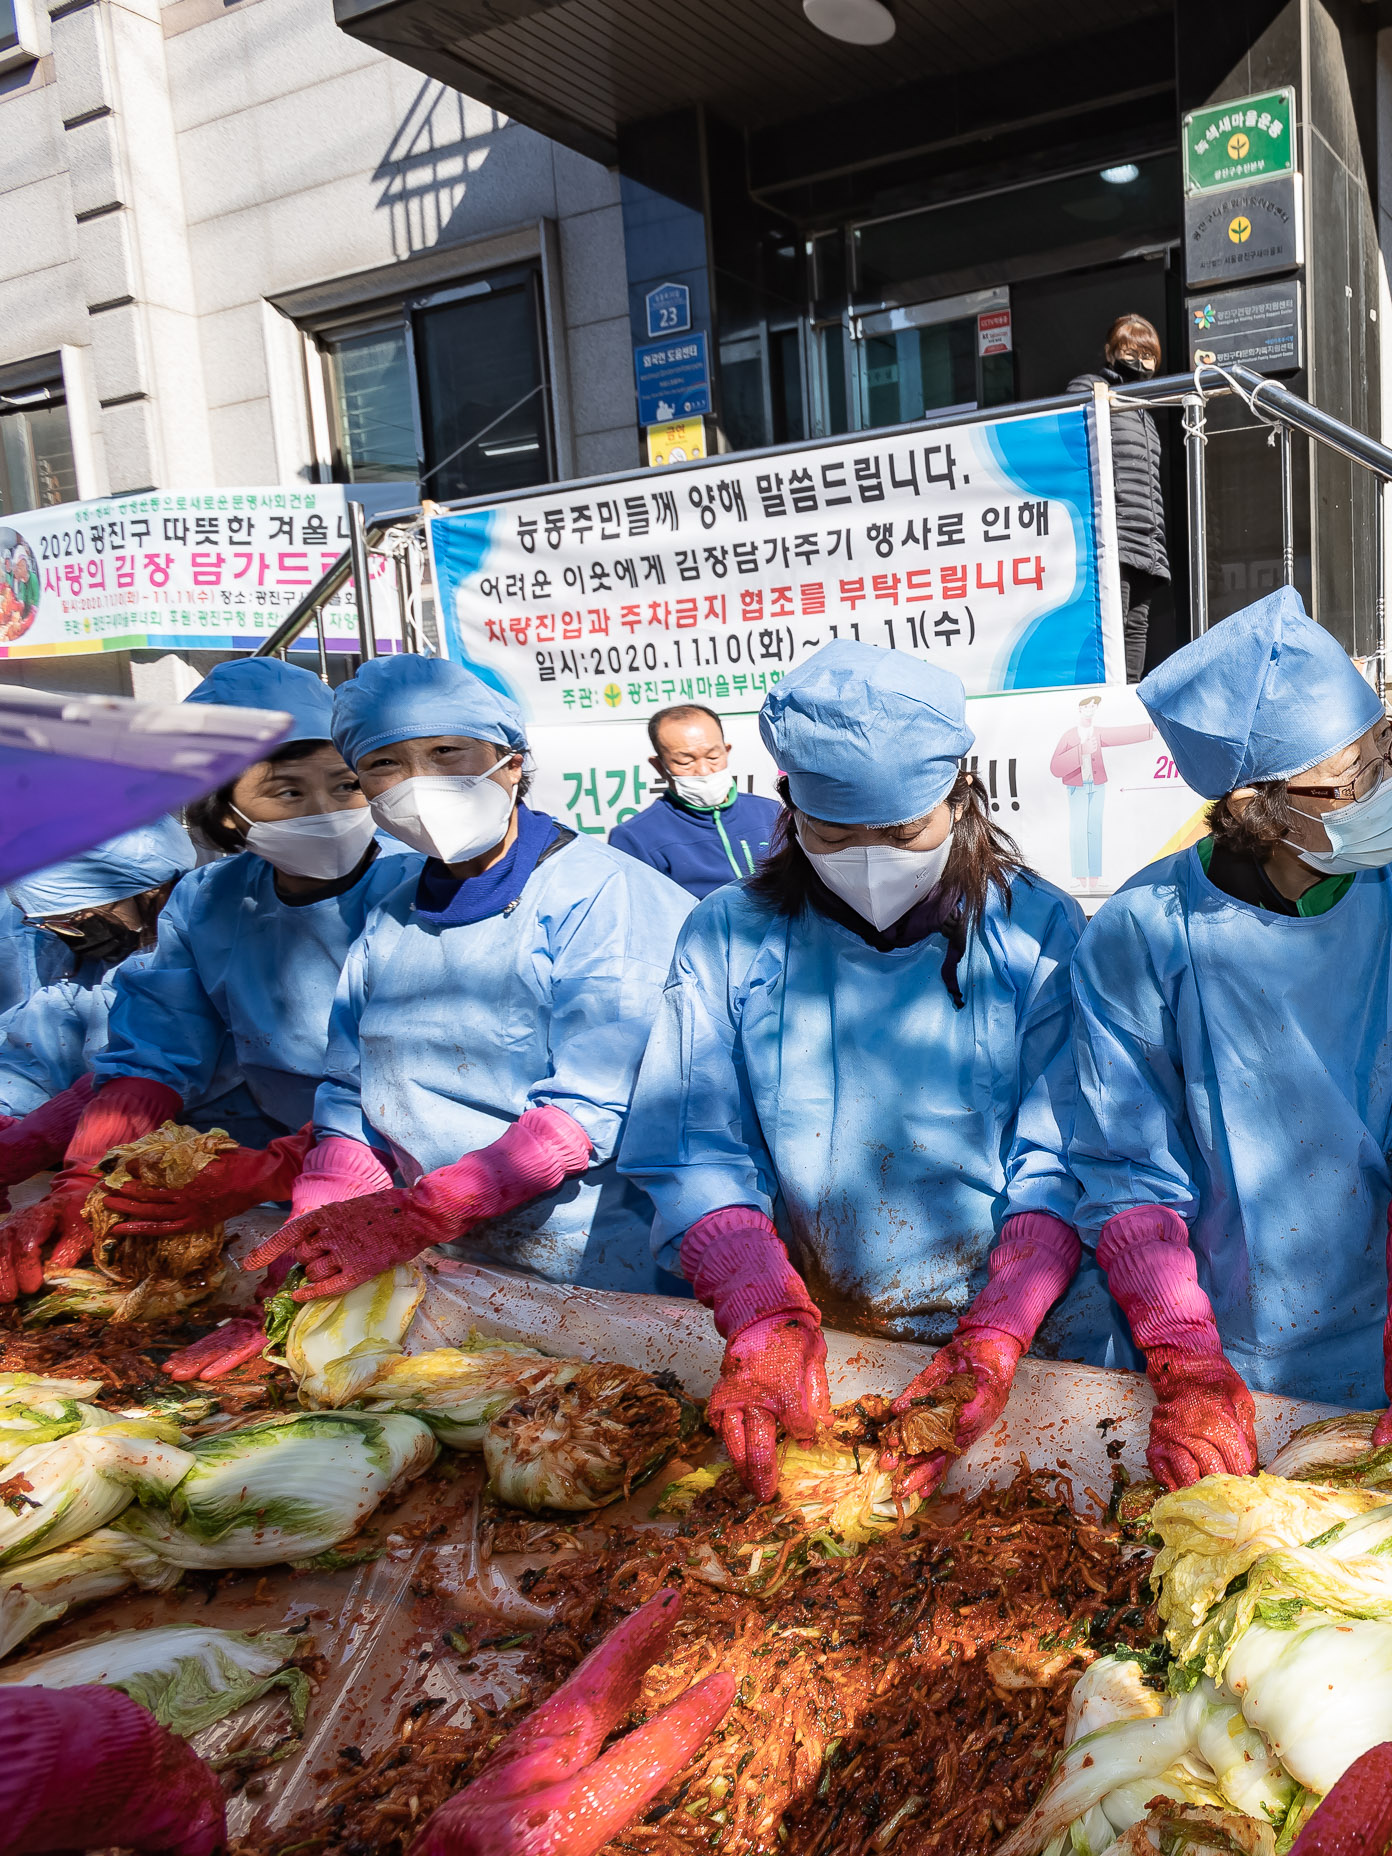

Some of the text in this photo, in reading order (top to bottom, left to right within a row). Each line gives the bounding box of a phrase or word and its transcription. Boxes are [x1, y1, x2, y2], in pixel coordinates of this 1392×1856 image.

[1194, 109, 1284, 155] 녹색새마을운동
[660, 307, 678, 328] 23
[666, 424, 685, 441] 금연
[517, 443, 970, 553] 능동주민들께 양해 말씀드립니다.
[40, 529, 85, 560] 2020
[90, 519, 152, 554] 광진구
[163, 517, 256, 547] 따뜻한
[480, 499, 1050, 604] 어려운 이웃에게 김장담가주기 행사로 인해
[44, 558, 107, 598] 사랑의
[115, 552, 176, 589] 김장
[484, 555, 1046, 646] 차량진입과 주차금지 협조를 부탁드립니다
[562, 687, 599, 710] 주관:
